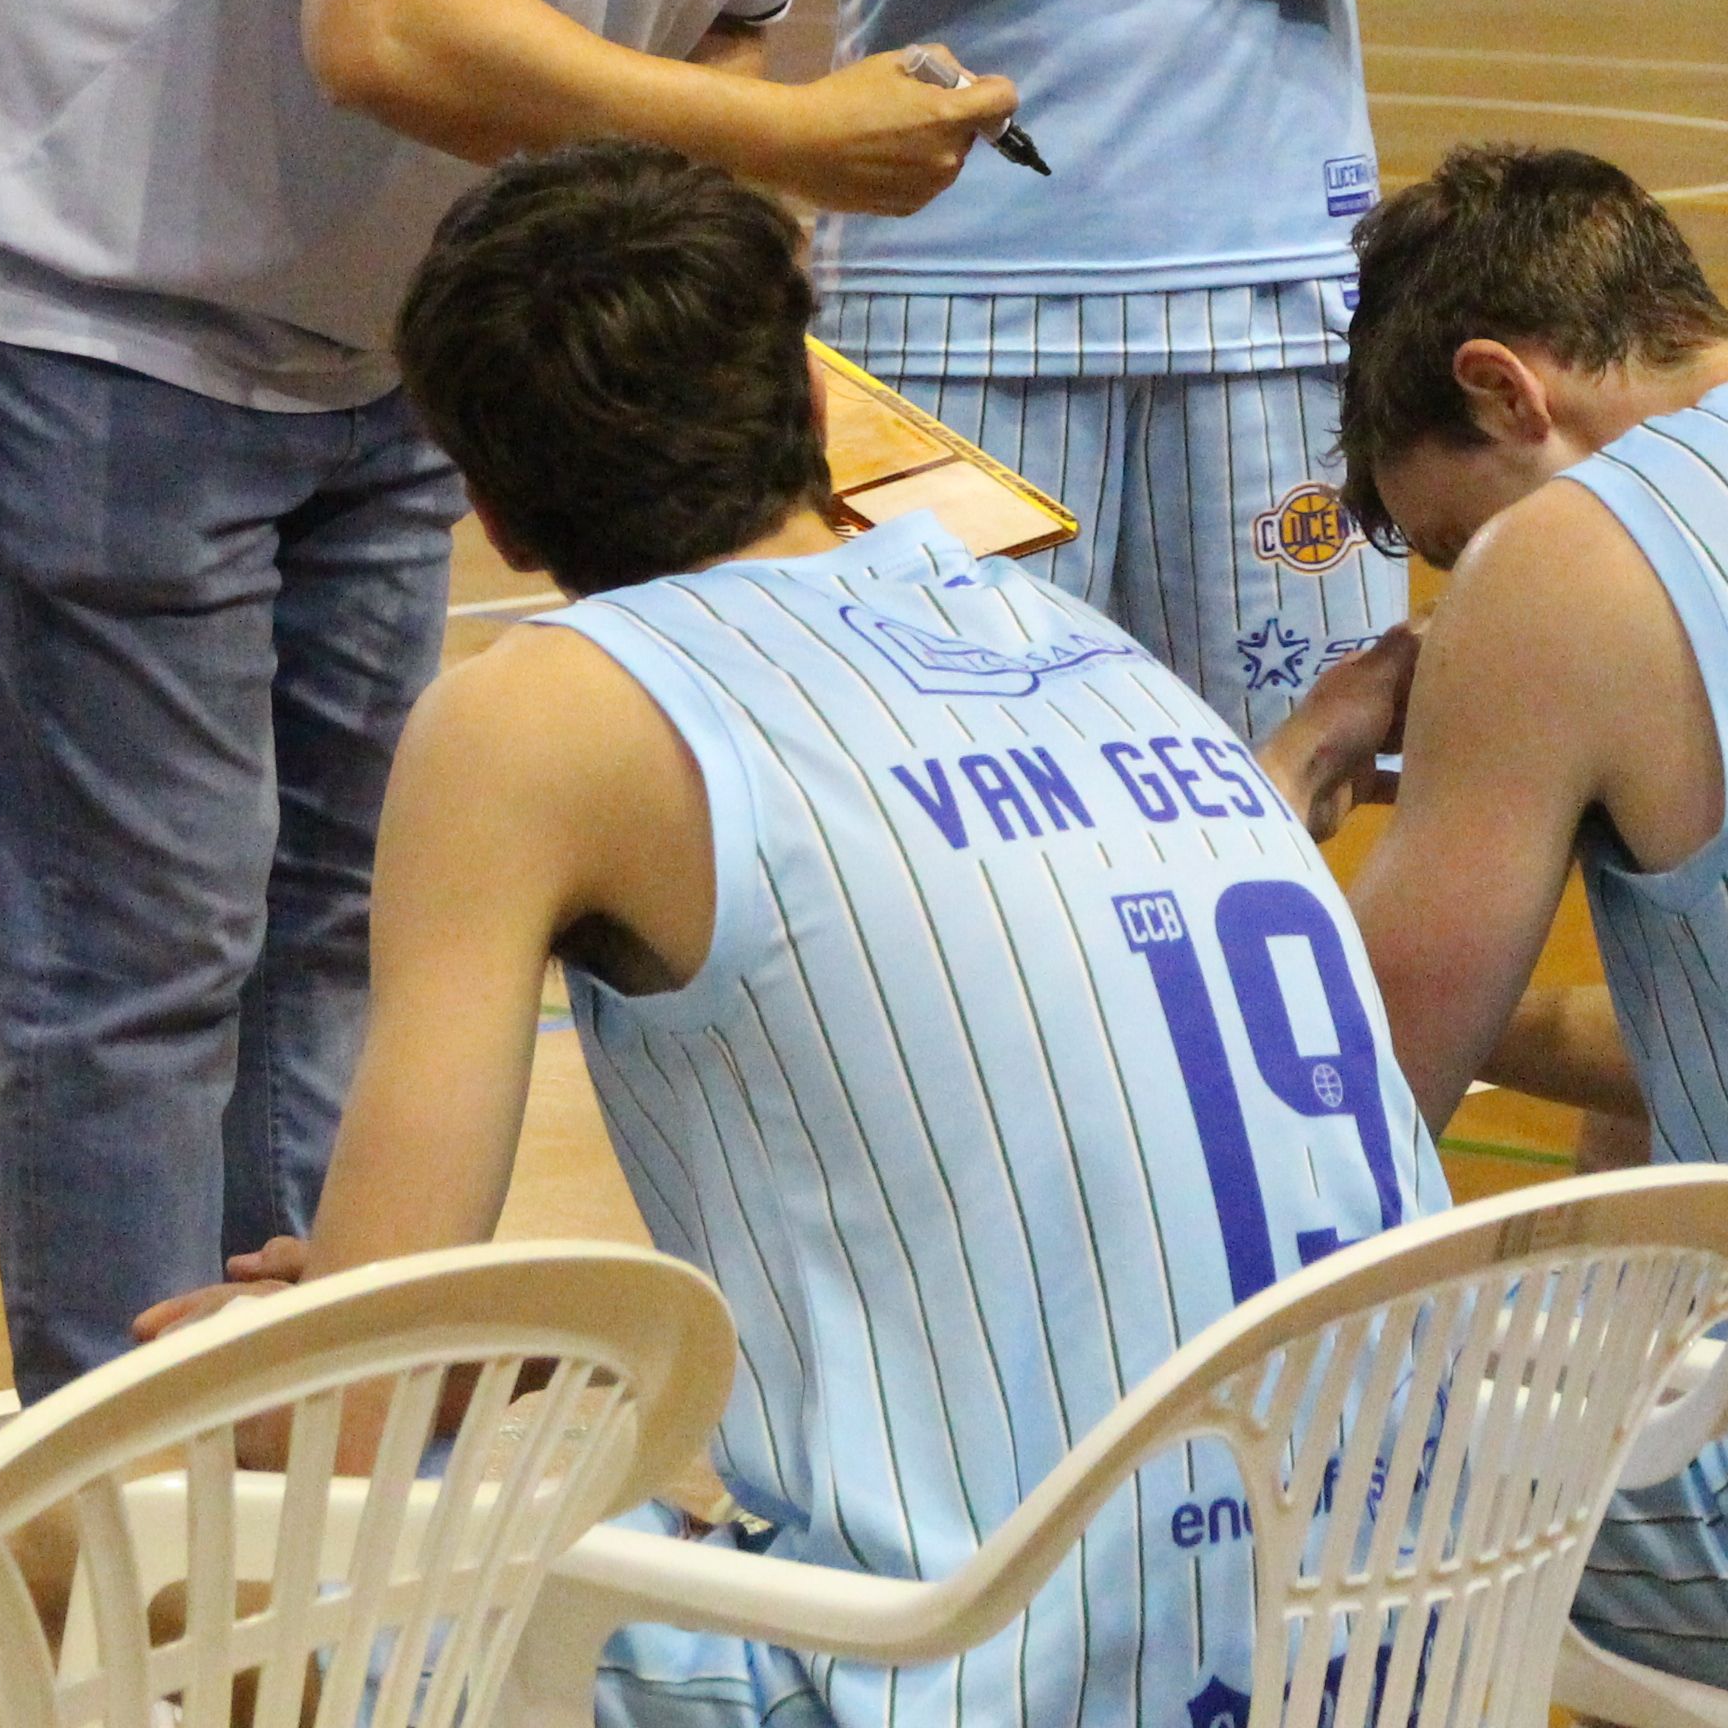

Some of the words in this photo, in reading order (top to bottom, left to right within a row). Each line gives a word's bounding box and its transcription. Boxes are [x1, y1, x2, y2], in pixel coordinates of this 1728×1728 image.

[891, 744, 1094, 850] VAN
[1120, 896, 1186, 944] CCB
[1111, 880, 1403, 1306] 19
